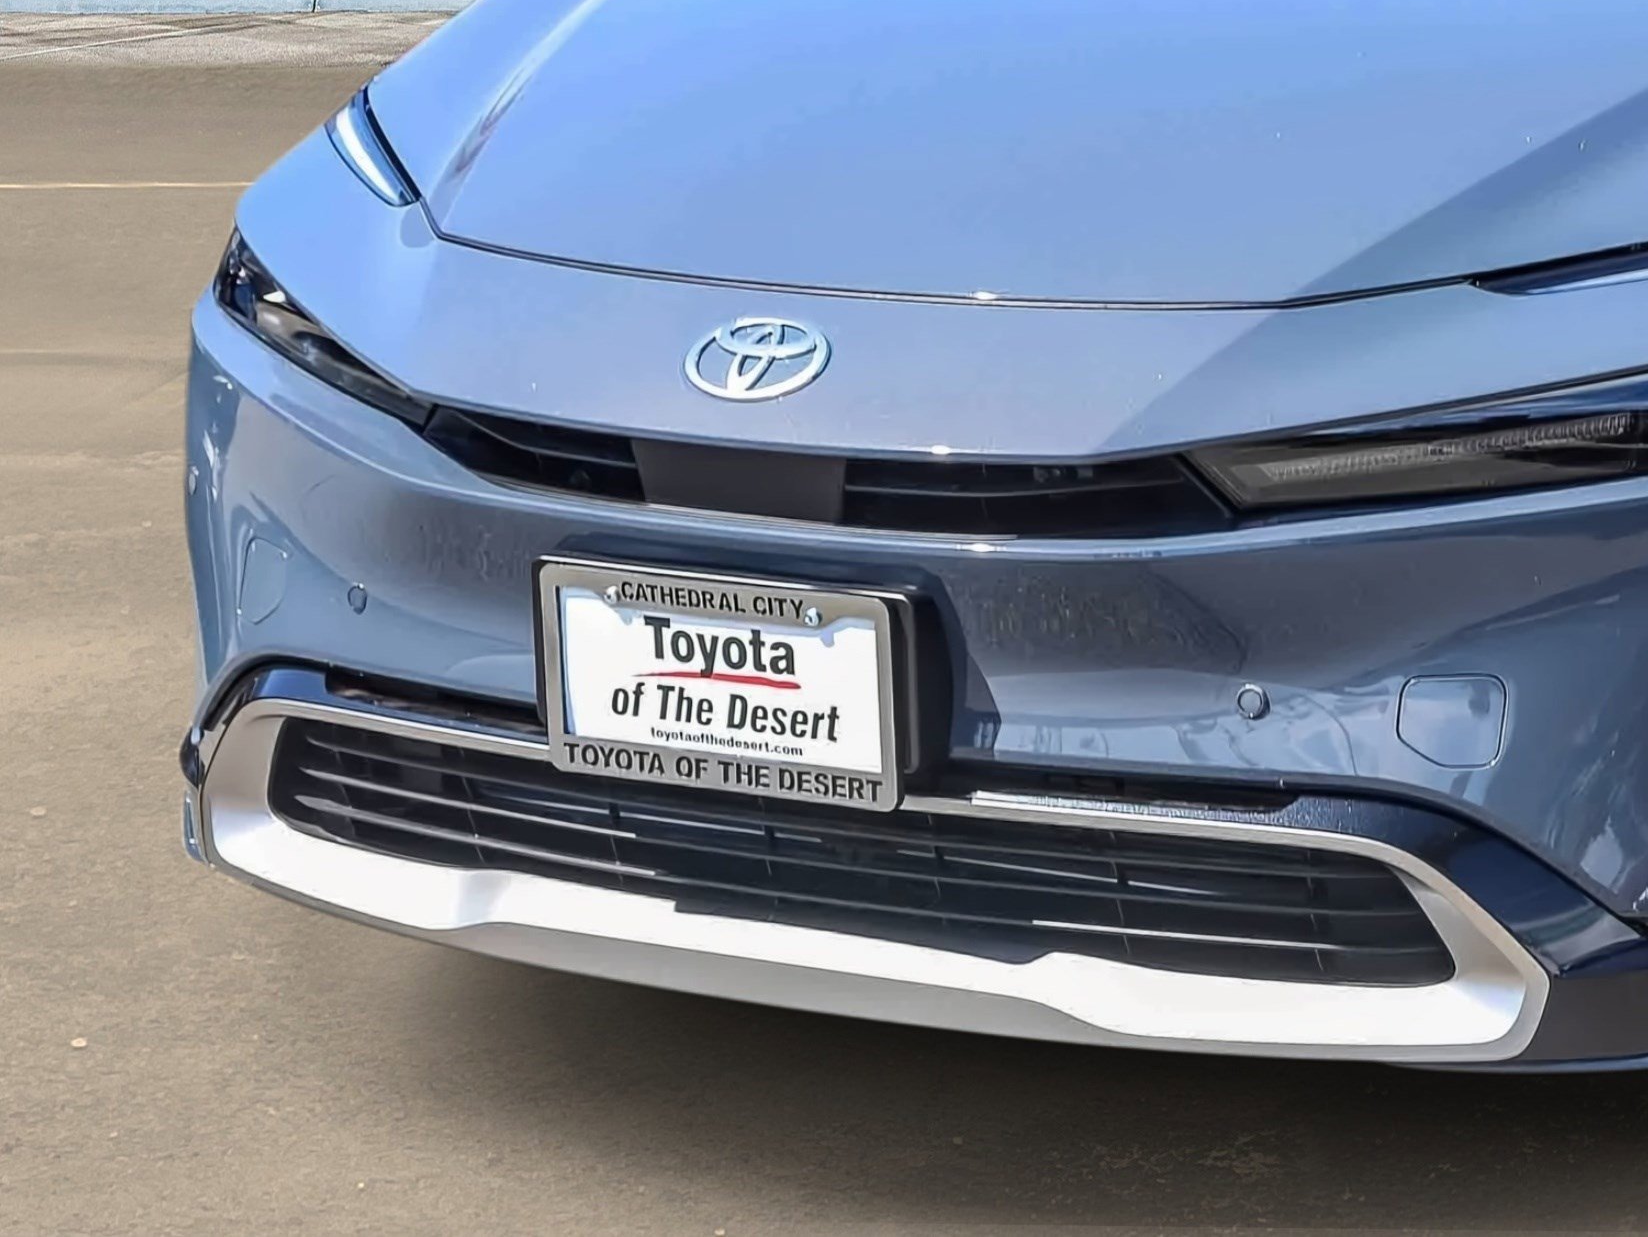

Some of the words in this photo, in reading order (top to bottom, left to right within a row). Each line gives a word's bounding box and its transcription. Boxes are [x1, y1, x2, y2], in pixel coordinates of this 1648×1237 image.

[620, 581, 747, 614] CATHEDRAL
[753, 596, 804, 620] CITY
[644, 616, 796, 678] Toyota
[611, 682, 646, 717] of
[656, 684, 714, 726] The
[727, 693, 840, 742] Desert
[650, 726, 803, 756] toyotaofthedesert.com
[563, 743, 666, 777] TOYOTA
[675, 756, 708, 781] OF
[718, 762, 770, 789] THE
[778, 769, 884, 803] DESERT
